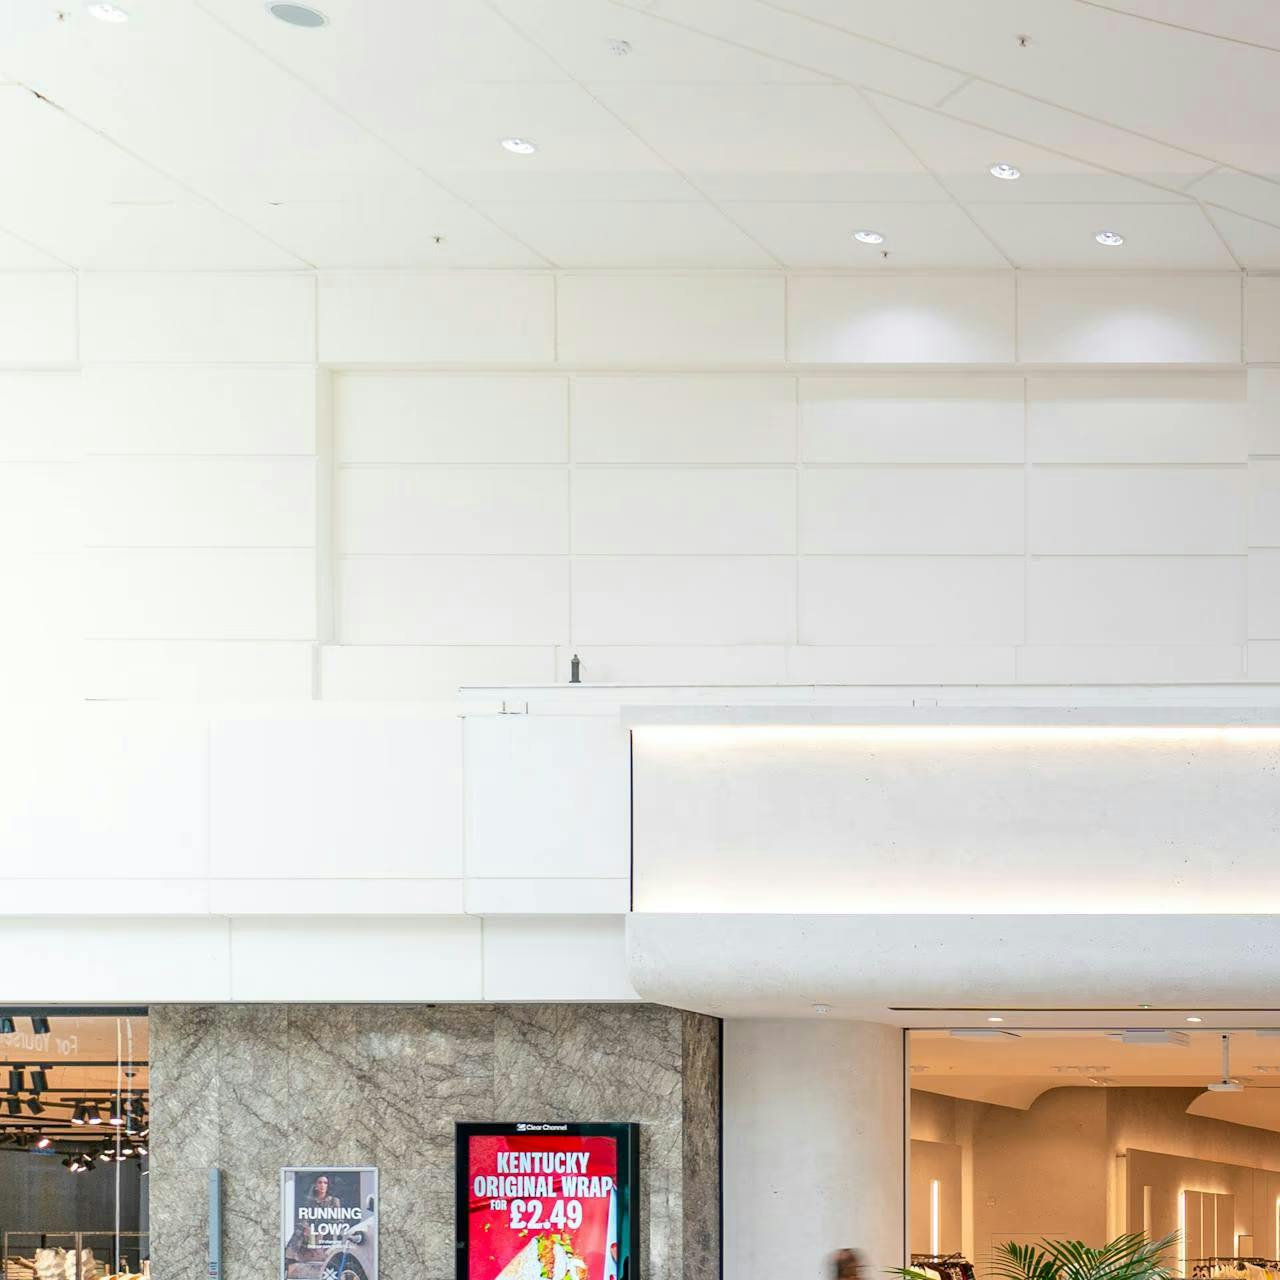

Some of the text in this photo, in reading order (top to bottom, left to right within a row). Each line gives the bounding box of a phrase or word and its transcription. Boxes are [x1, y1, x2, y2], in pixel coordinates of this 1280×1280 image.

[526, 1123, 568, 1131] Clear Channel
[496, 1151, 590, 1174] KENTUCKY
[473, 1175, 613, 1198] ORIGINAL WRAP
[298, 1207, 362, 1220] RUNNING
[490, 1199, 583, 1230] FOR £2.49
[310, 1223, 350, 1236] LOW?
